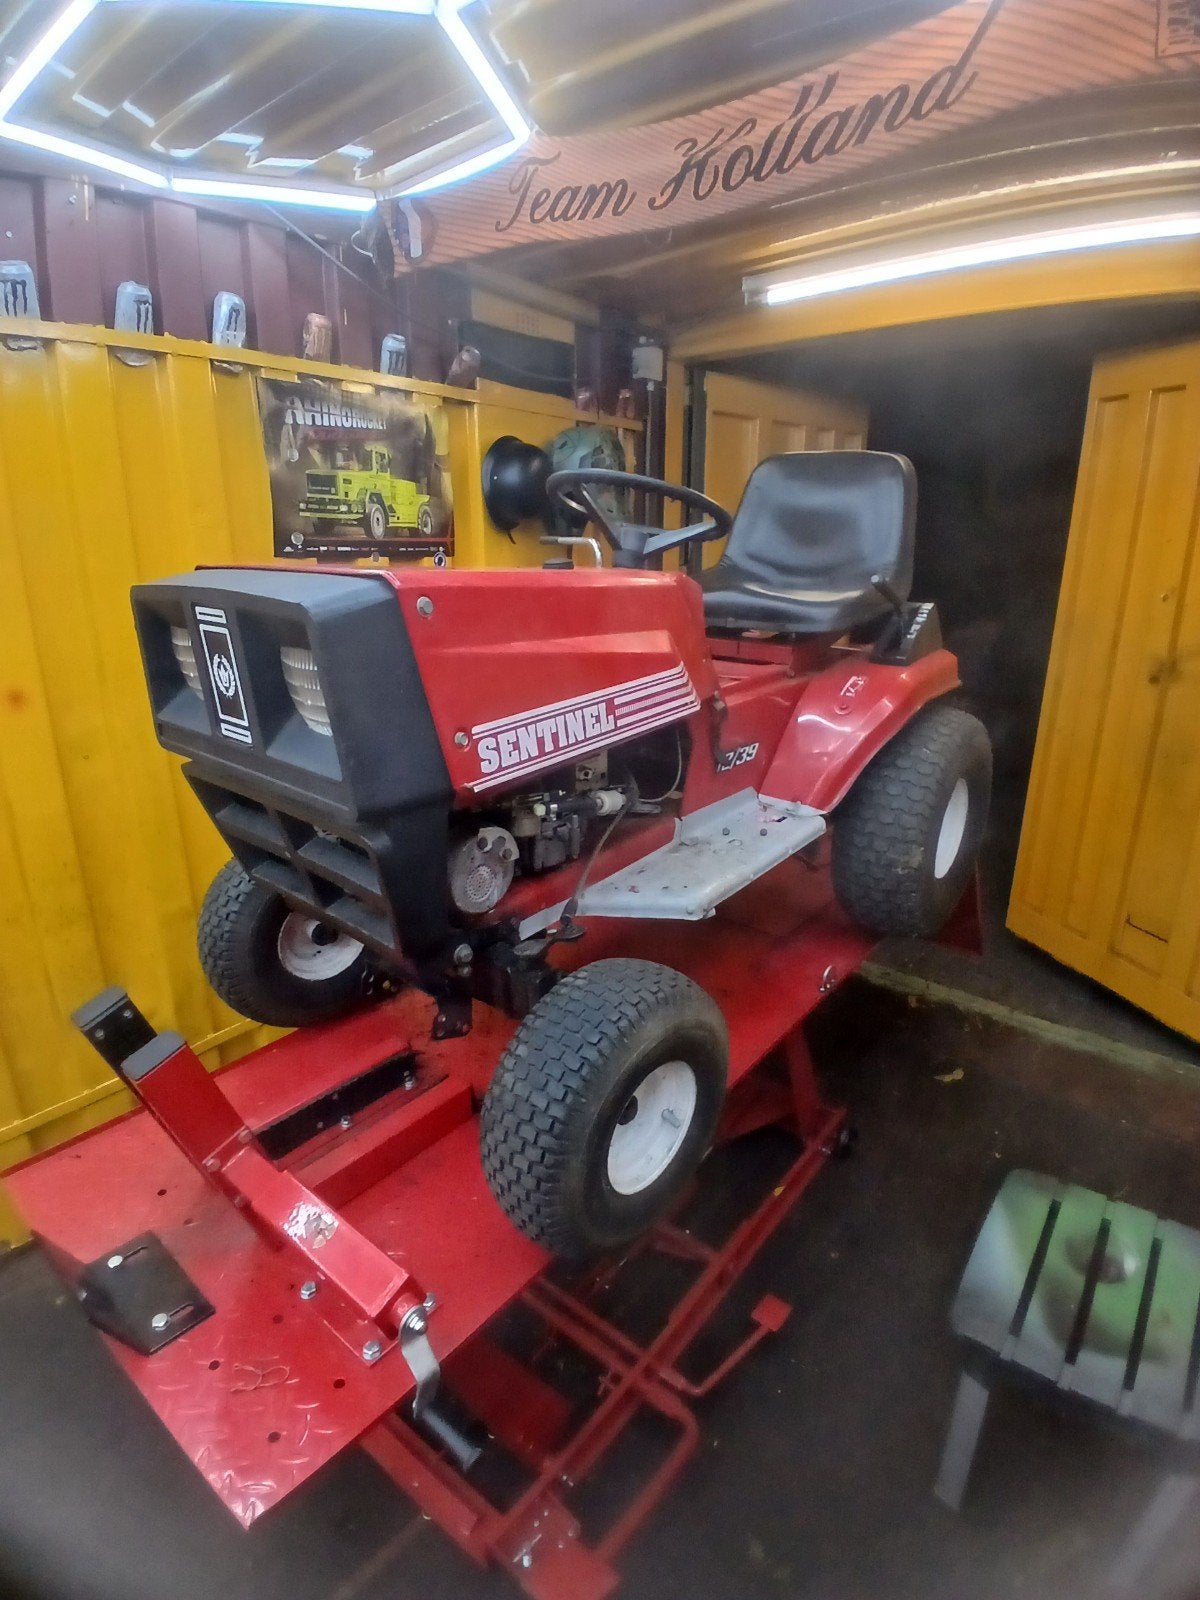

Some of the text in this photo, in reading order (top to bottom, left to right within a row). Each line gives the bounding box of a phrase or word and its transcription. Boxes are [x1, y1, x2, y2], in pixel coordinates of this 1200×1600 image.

[495, 0, 1001, 232] Team Holland
[478, 702, 615, 773] SENTINEL
